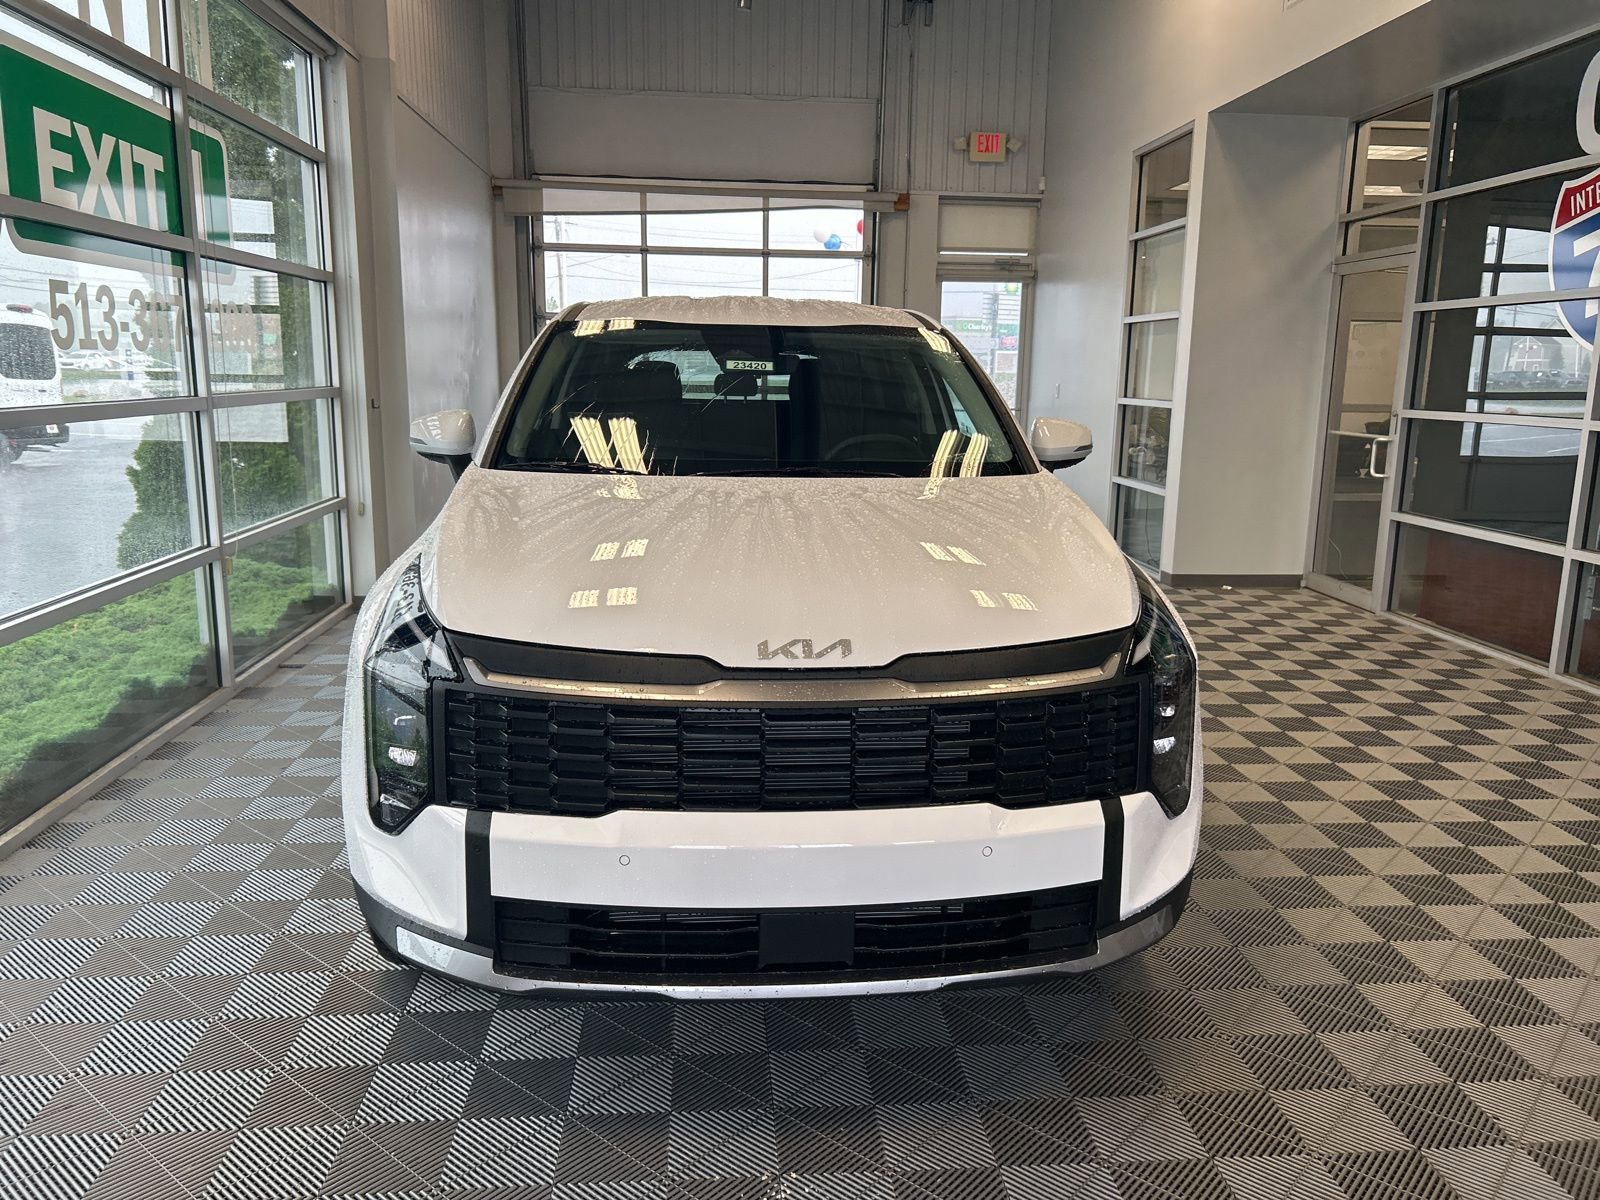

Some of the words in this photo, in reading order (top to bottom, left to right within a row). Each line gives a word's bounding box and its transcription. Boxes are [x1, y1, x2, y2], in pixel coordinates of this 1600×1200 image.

[977, 134, 1000, 153] EXIT
[33, 105, 165, 231] EXIT
[732, 361, 767, 370] 23420
[757, 638, 852, 660] KIA
